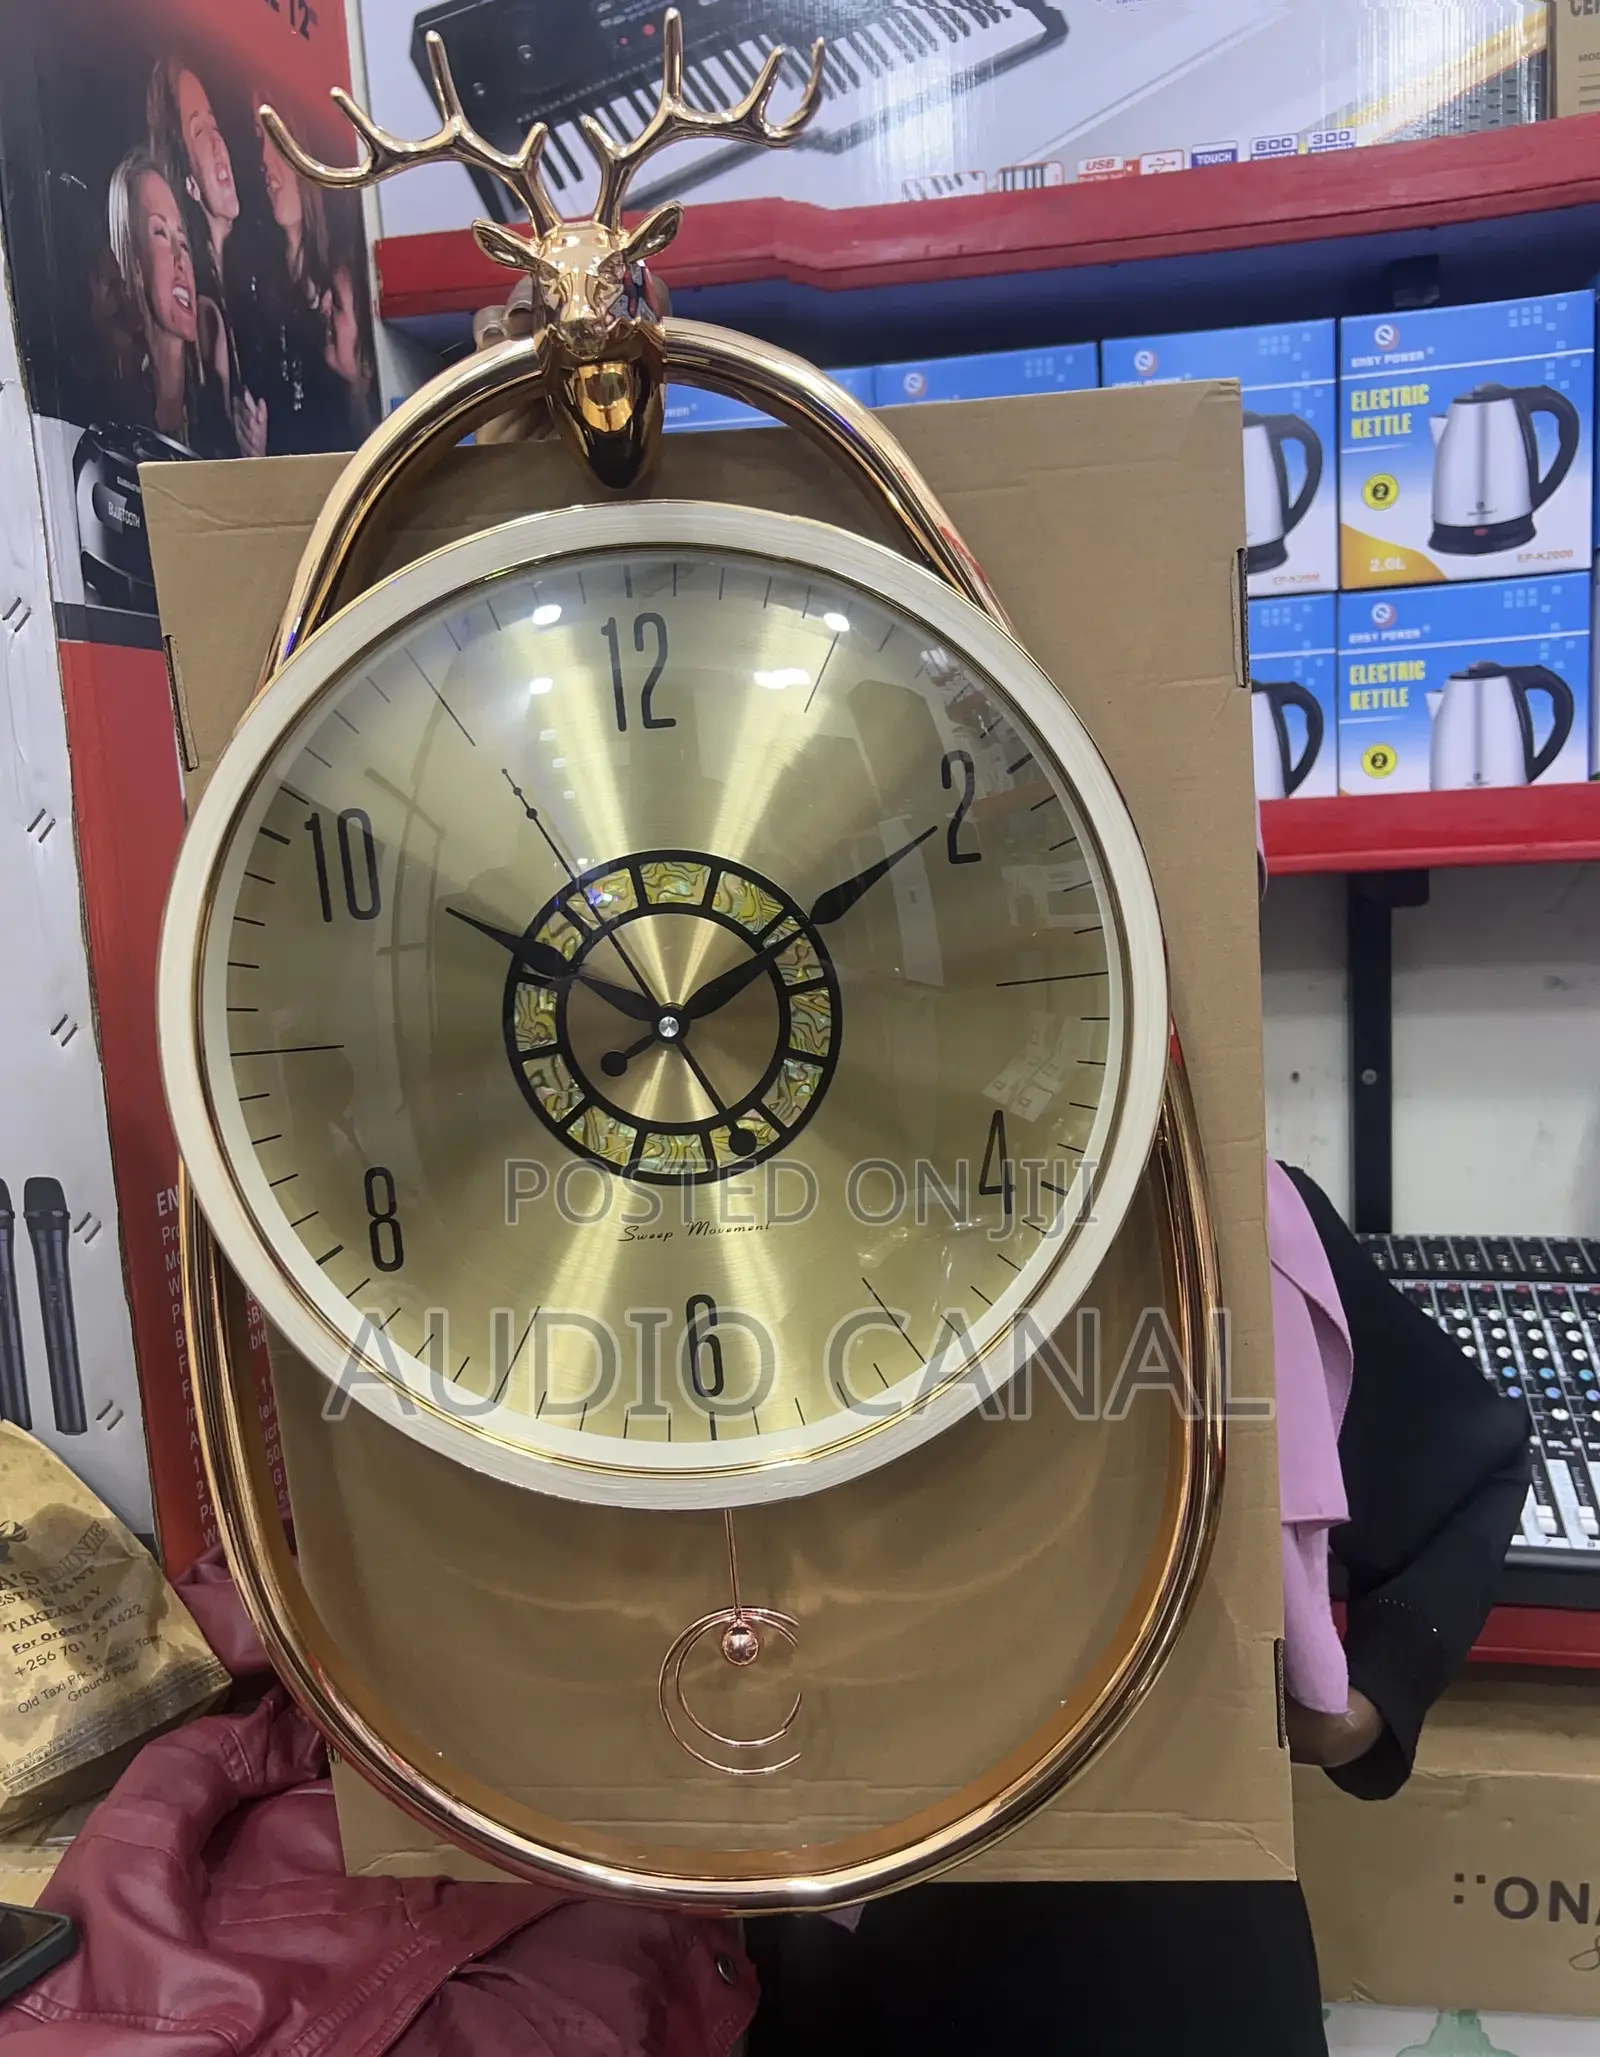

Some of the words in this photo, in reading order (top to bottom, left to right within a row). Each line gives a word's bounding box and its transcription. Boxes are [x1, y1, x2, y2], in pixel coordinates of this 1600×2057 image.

[1256, 138, 1293, 151] 600
[1312, 131, 1351, 145] 300
[1086, 159, 1116, 171] USB
[1196, 152, 1233, 165] TOUCH
[1384, 350, 1425, 364] POWER
[1351, 383, 1430, 412] ELECTRIC
[1351, 412, 1412, 440] KETTLE
[1369, 556, 1407, 572] 2.0L
[600, 612, 677, 732] 12
[1350, 660, 1426, 686] ELECTRIC
[1350, 686, 1410, 711] KETTLE
[940, 749, 982, 866] 2
[304, 806, 382, 923] 10
[978, 1110, 1016, 1215] 4
[364, 1166, 405, 1273] 8
[617, 1225, 674, 1243] Sweep
[686, 1220, 772, 1238] Movement
[686, 1293, 725, 1397] 6
[4, 1586, 101, 1634] TAKEAWAY
[11, 1638, 37, 1654] For
[41, 1621, 91, 1641] Orders
[14, 1651, 57, 1678] +256
[18, 1697, 40, 1714] Old
[41, 1680, 66, 1700] Taxi
[67, 1671, 111, 1702] Ground
[1494, 1876, 1600, 1926] ON
